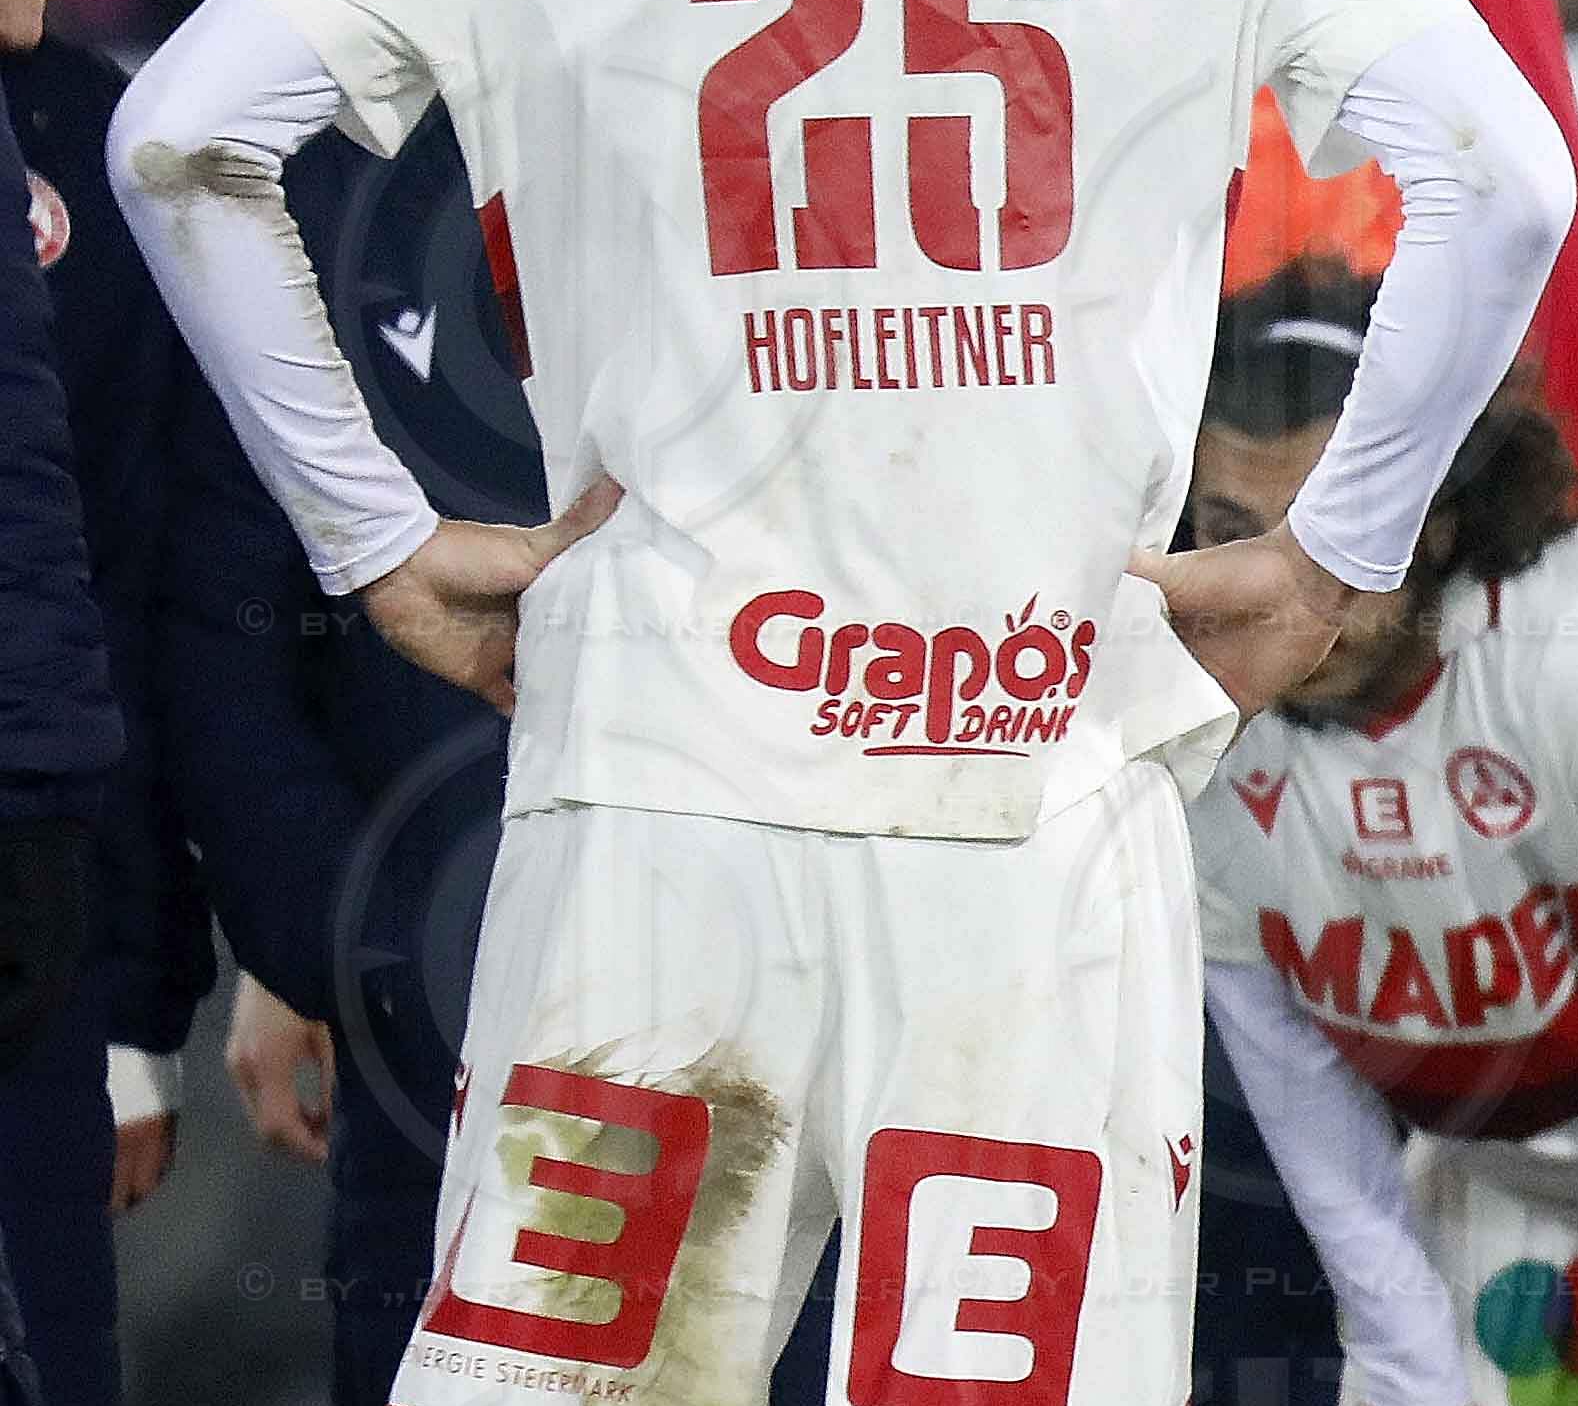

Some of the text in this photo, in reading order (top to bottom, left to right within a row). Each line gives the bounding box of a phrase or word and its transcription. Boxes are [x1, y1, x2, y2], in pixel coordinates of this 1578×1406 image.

[742, 302, 1057, 394] HOFLEITNER
[811, 698, 1076, 743] SOFT DRINK
